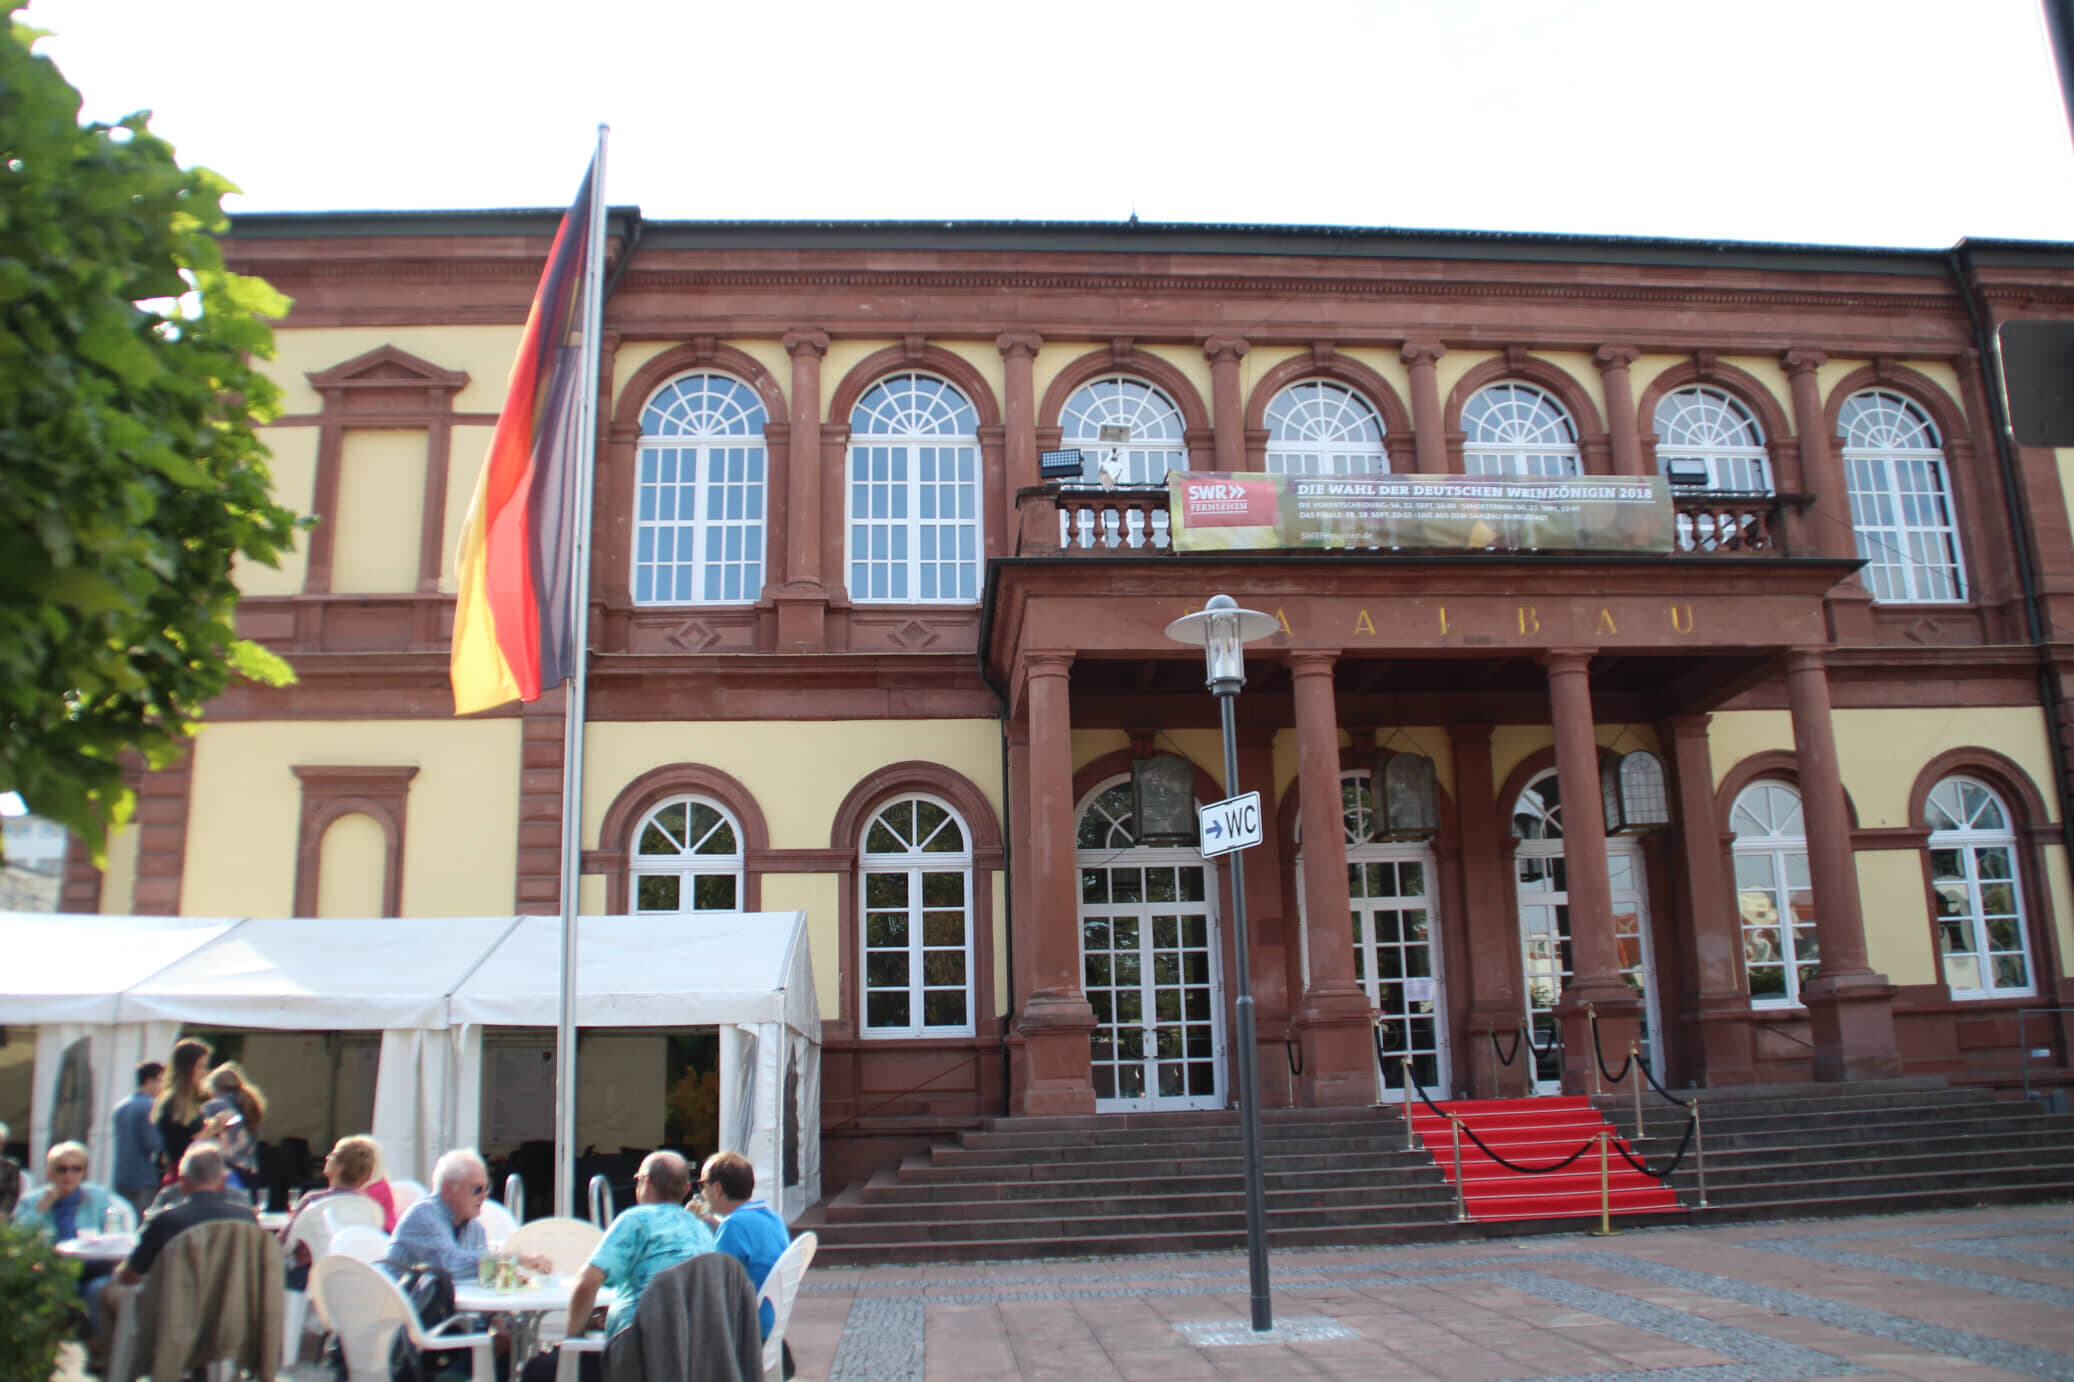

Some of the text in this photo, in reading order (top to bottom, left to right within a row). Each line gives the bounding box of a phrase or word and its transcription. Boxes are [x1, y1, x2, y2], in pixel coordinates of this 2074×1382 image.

[1188, 485, 1227, 500] SWR
[1297, 484, 1653, 499] DIE WAHL DER DEUTSCHEN WEINKÖNIGIN 2018
[1191, 503, 1248, 512] FERNSEHEN
[1225, 804, 1257, 839] WC
